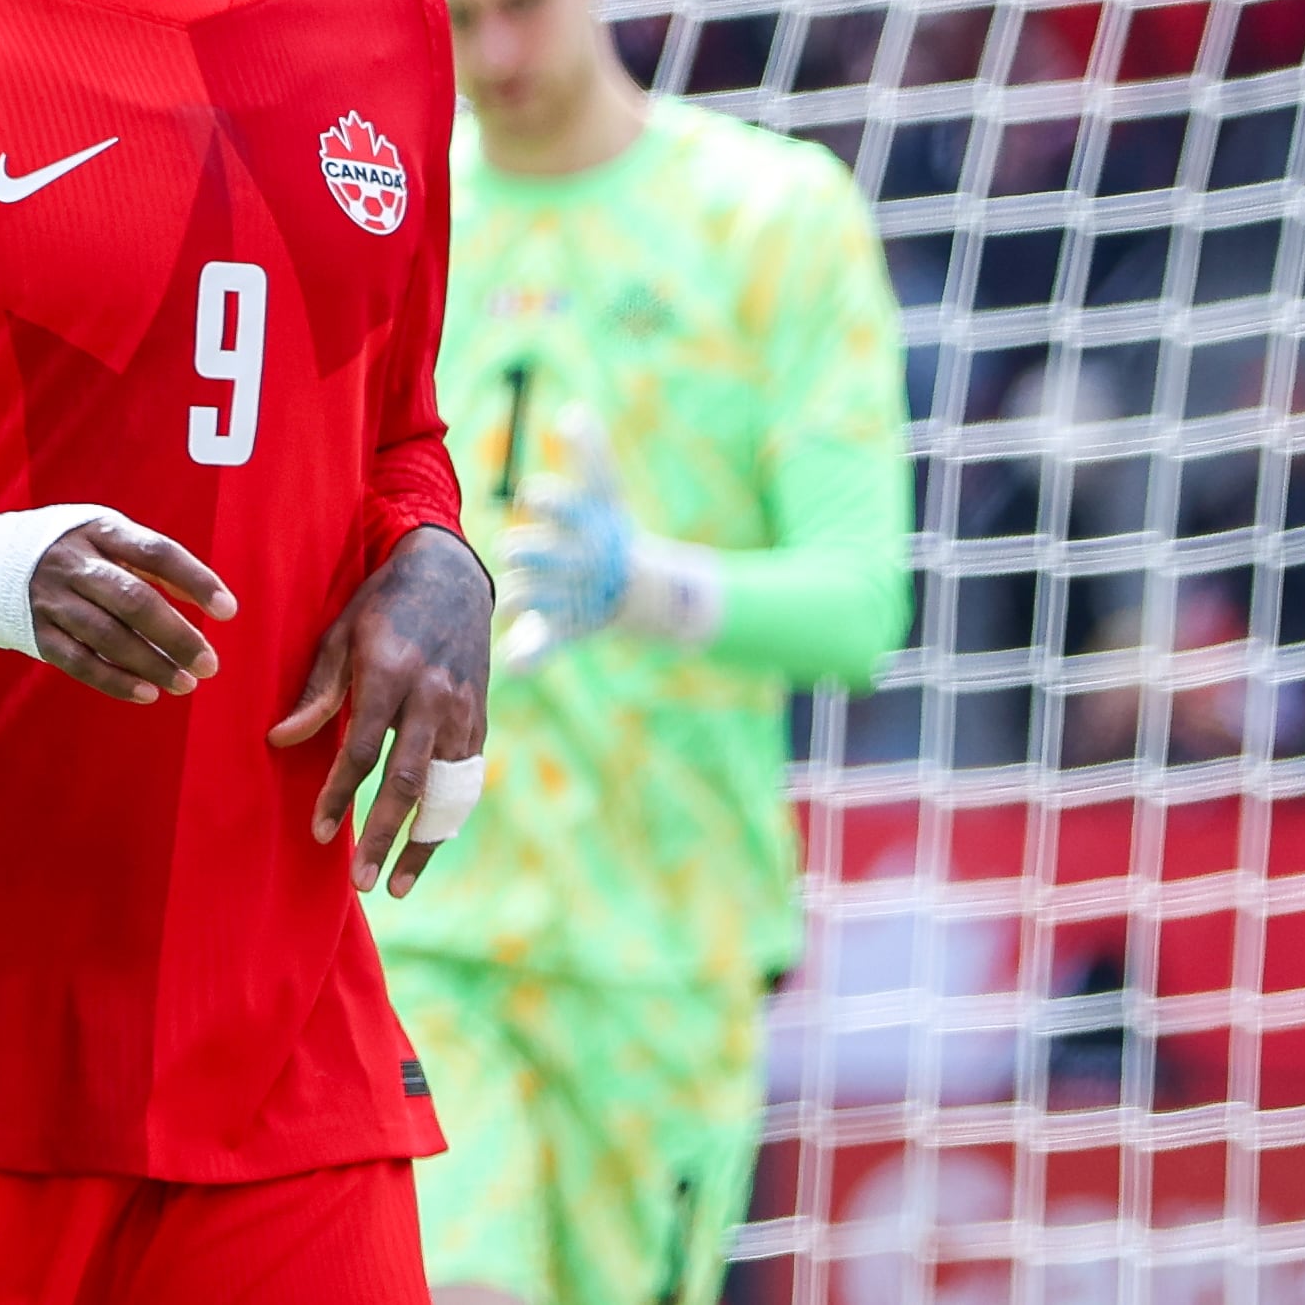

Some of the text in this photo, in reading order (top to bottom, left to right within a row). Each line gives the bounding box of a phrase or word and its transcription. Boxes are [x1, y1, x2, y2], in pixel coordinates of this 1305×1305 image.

[324, 161, 403, 190] CANADA
[189, 261, 267, 466] 9
[491, 360, 534, 503] 1
